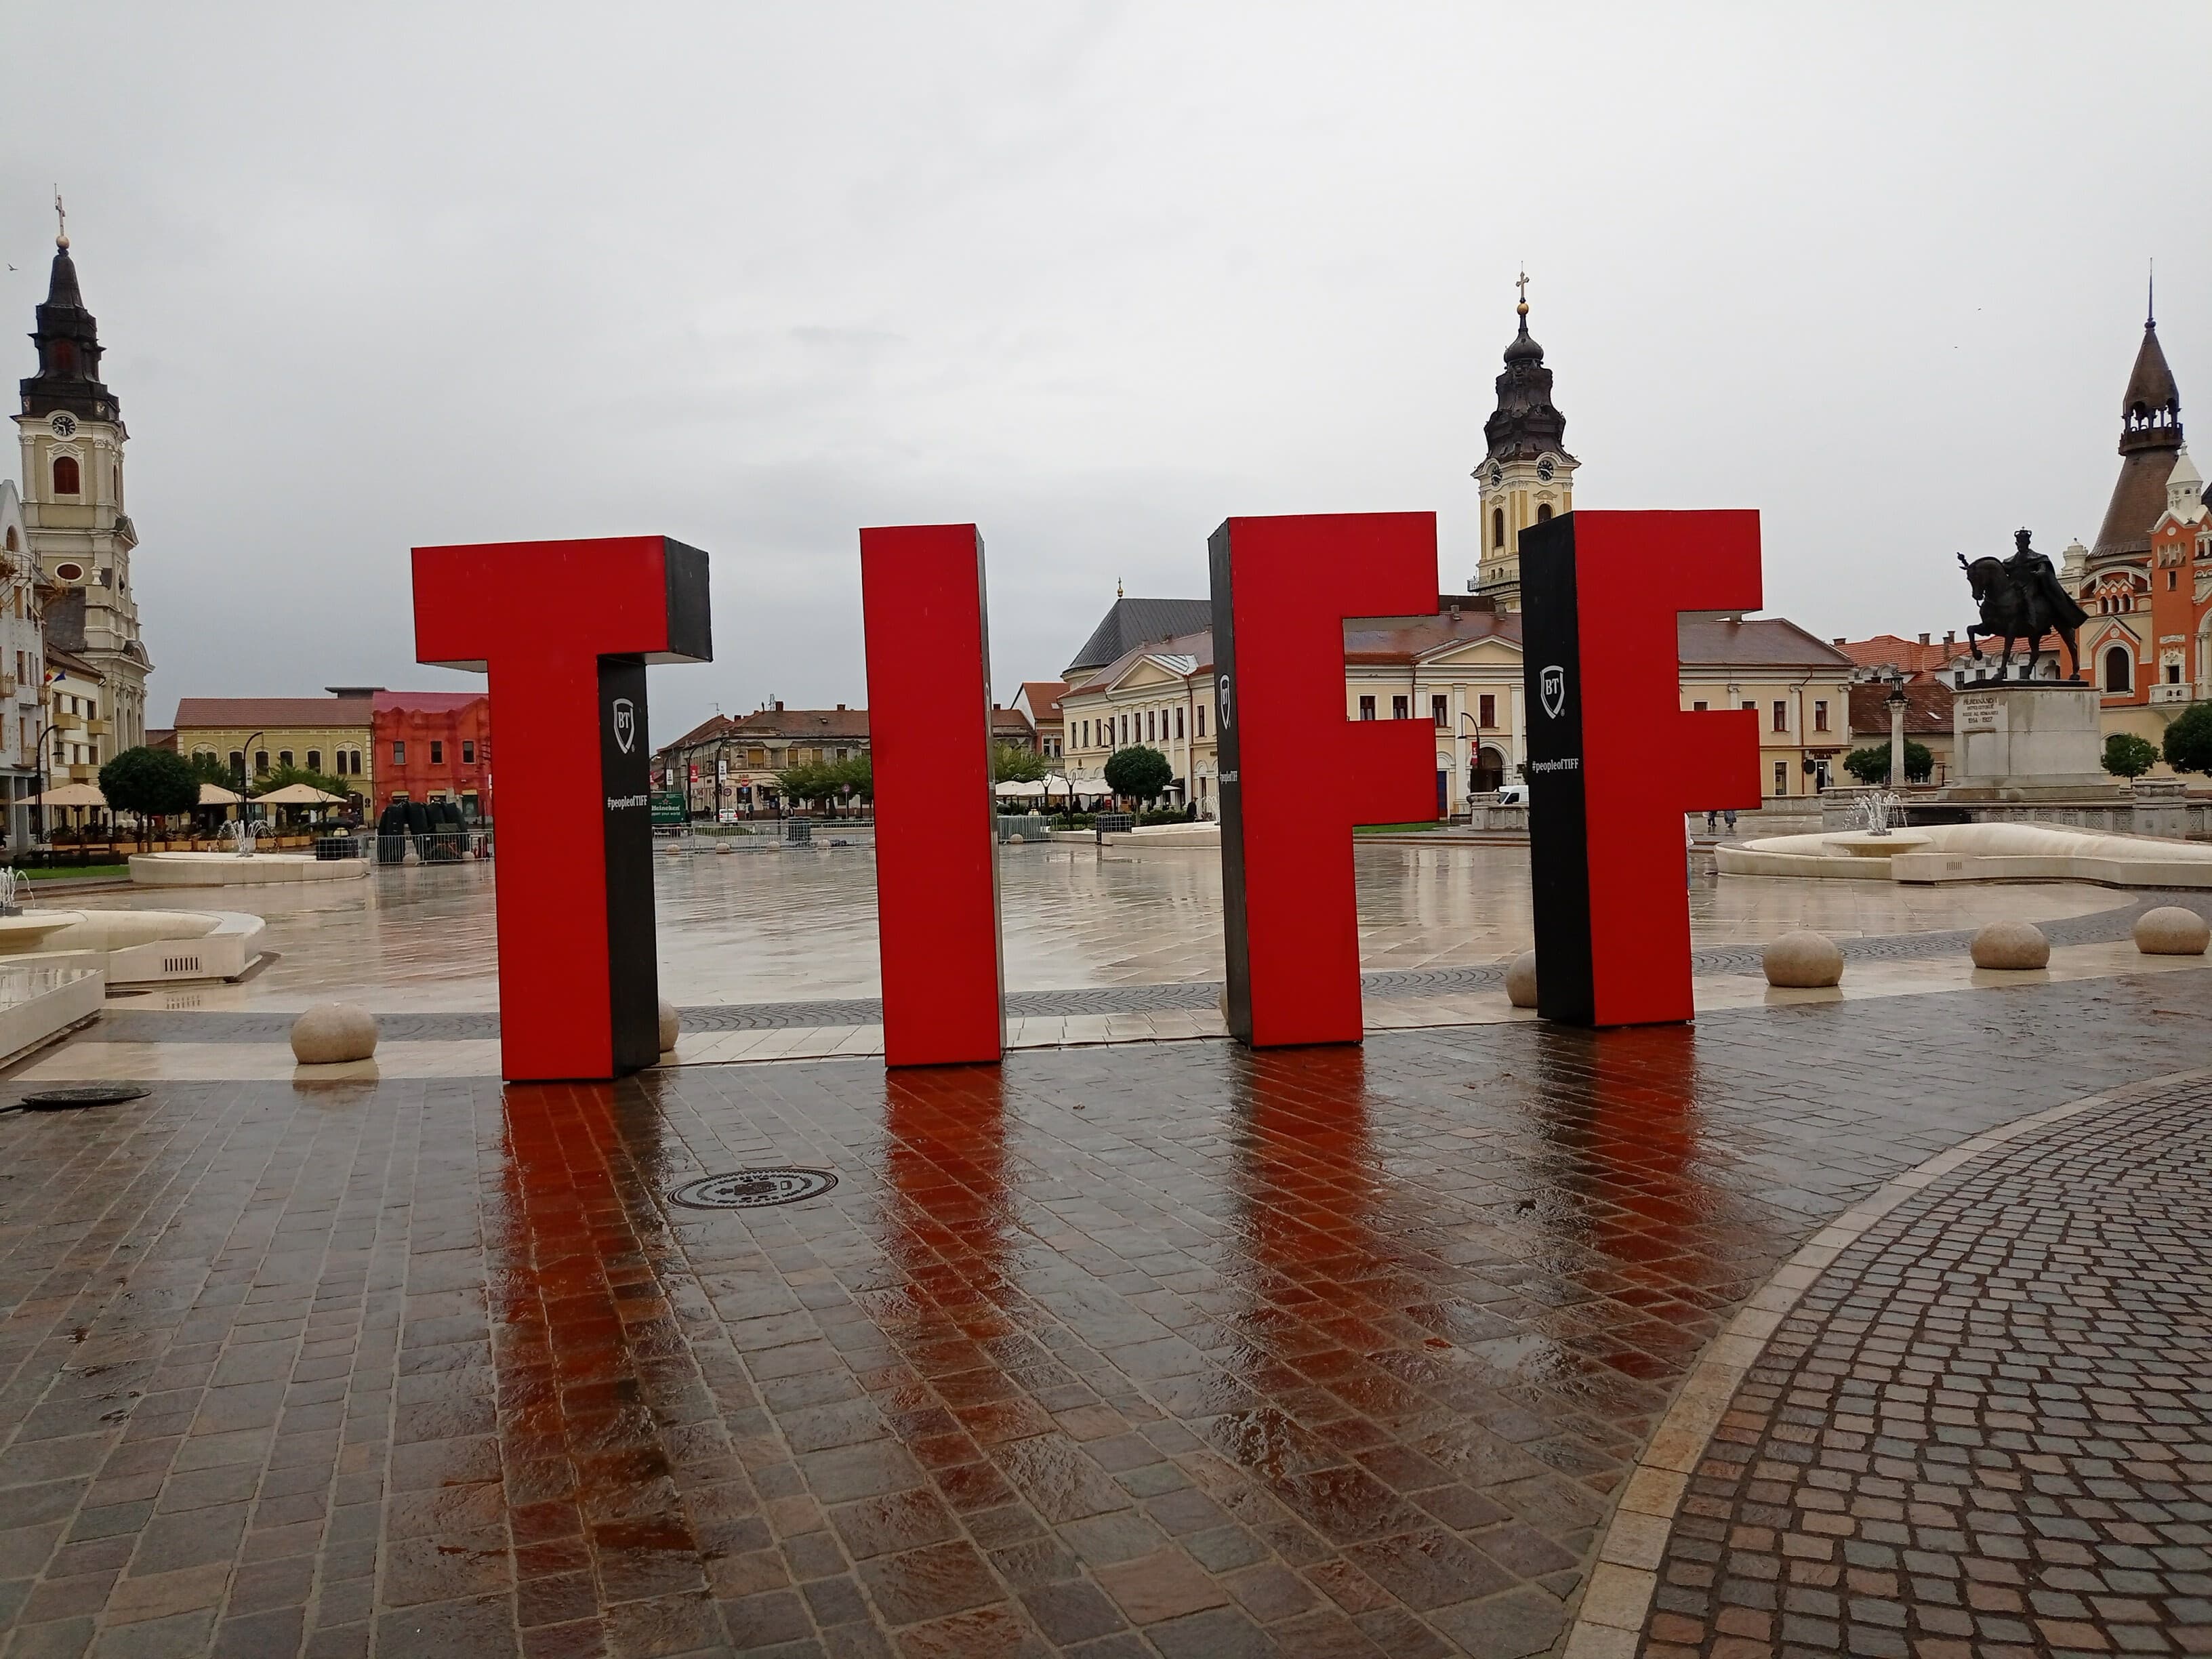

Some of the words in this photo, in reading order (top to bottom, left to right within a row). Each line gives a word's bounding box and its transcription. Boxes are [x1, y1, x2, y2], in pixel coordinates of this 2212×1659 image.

[1545, 678, 1559, 695] BT
[617, 711, 630, 729] BT
[1532, 758, 1578, 773] #peopleofTIFF
[411, 509, 1763, 1084] TIFF
[607, 795, 648, 811] #peopleofTIFF
